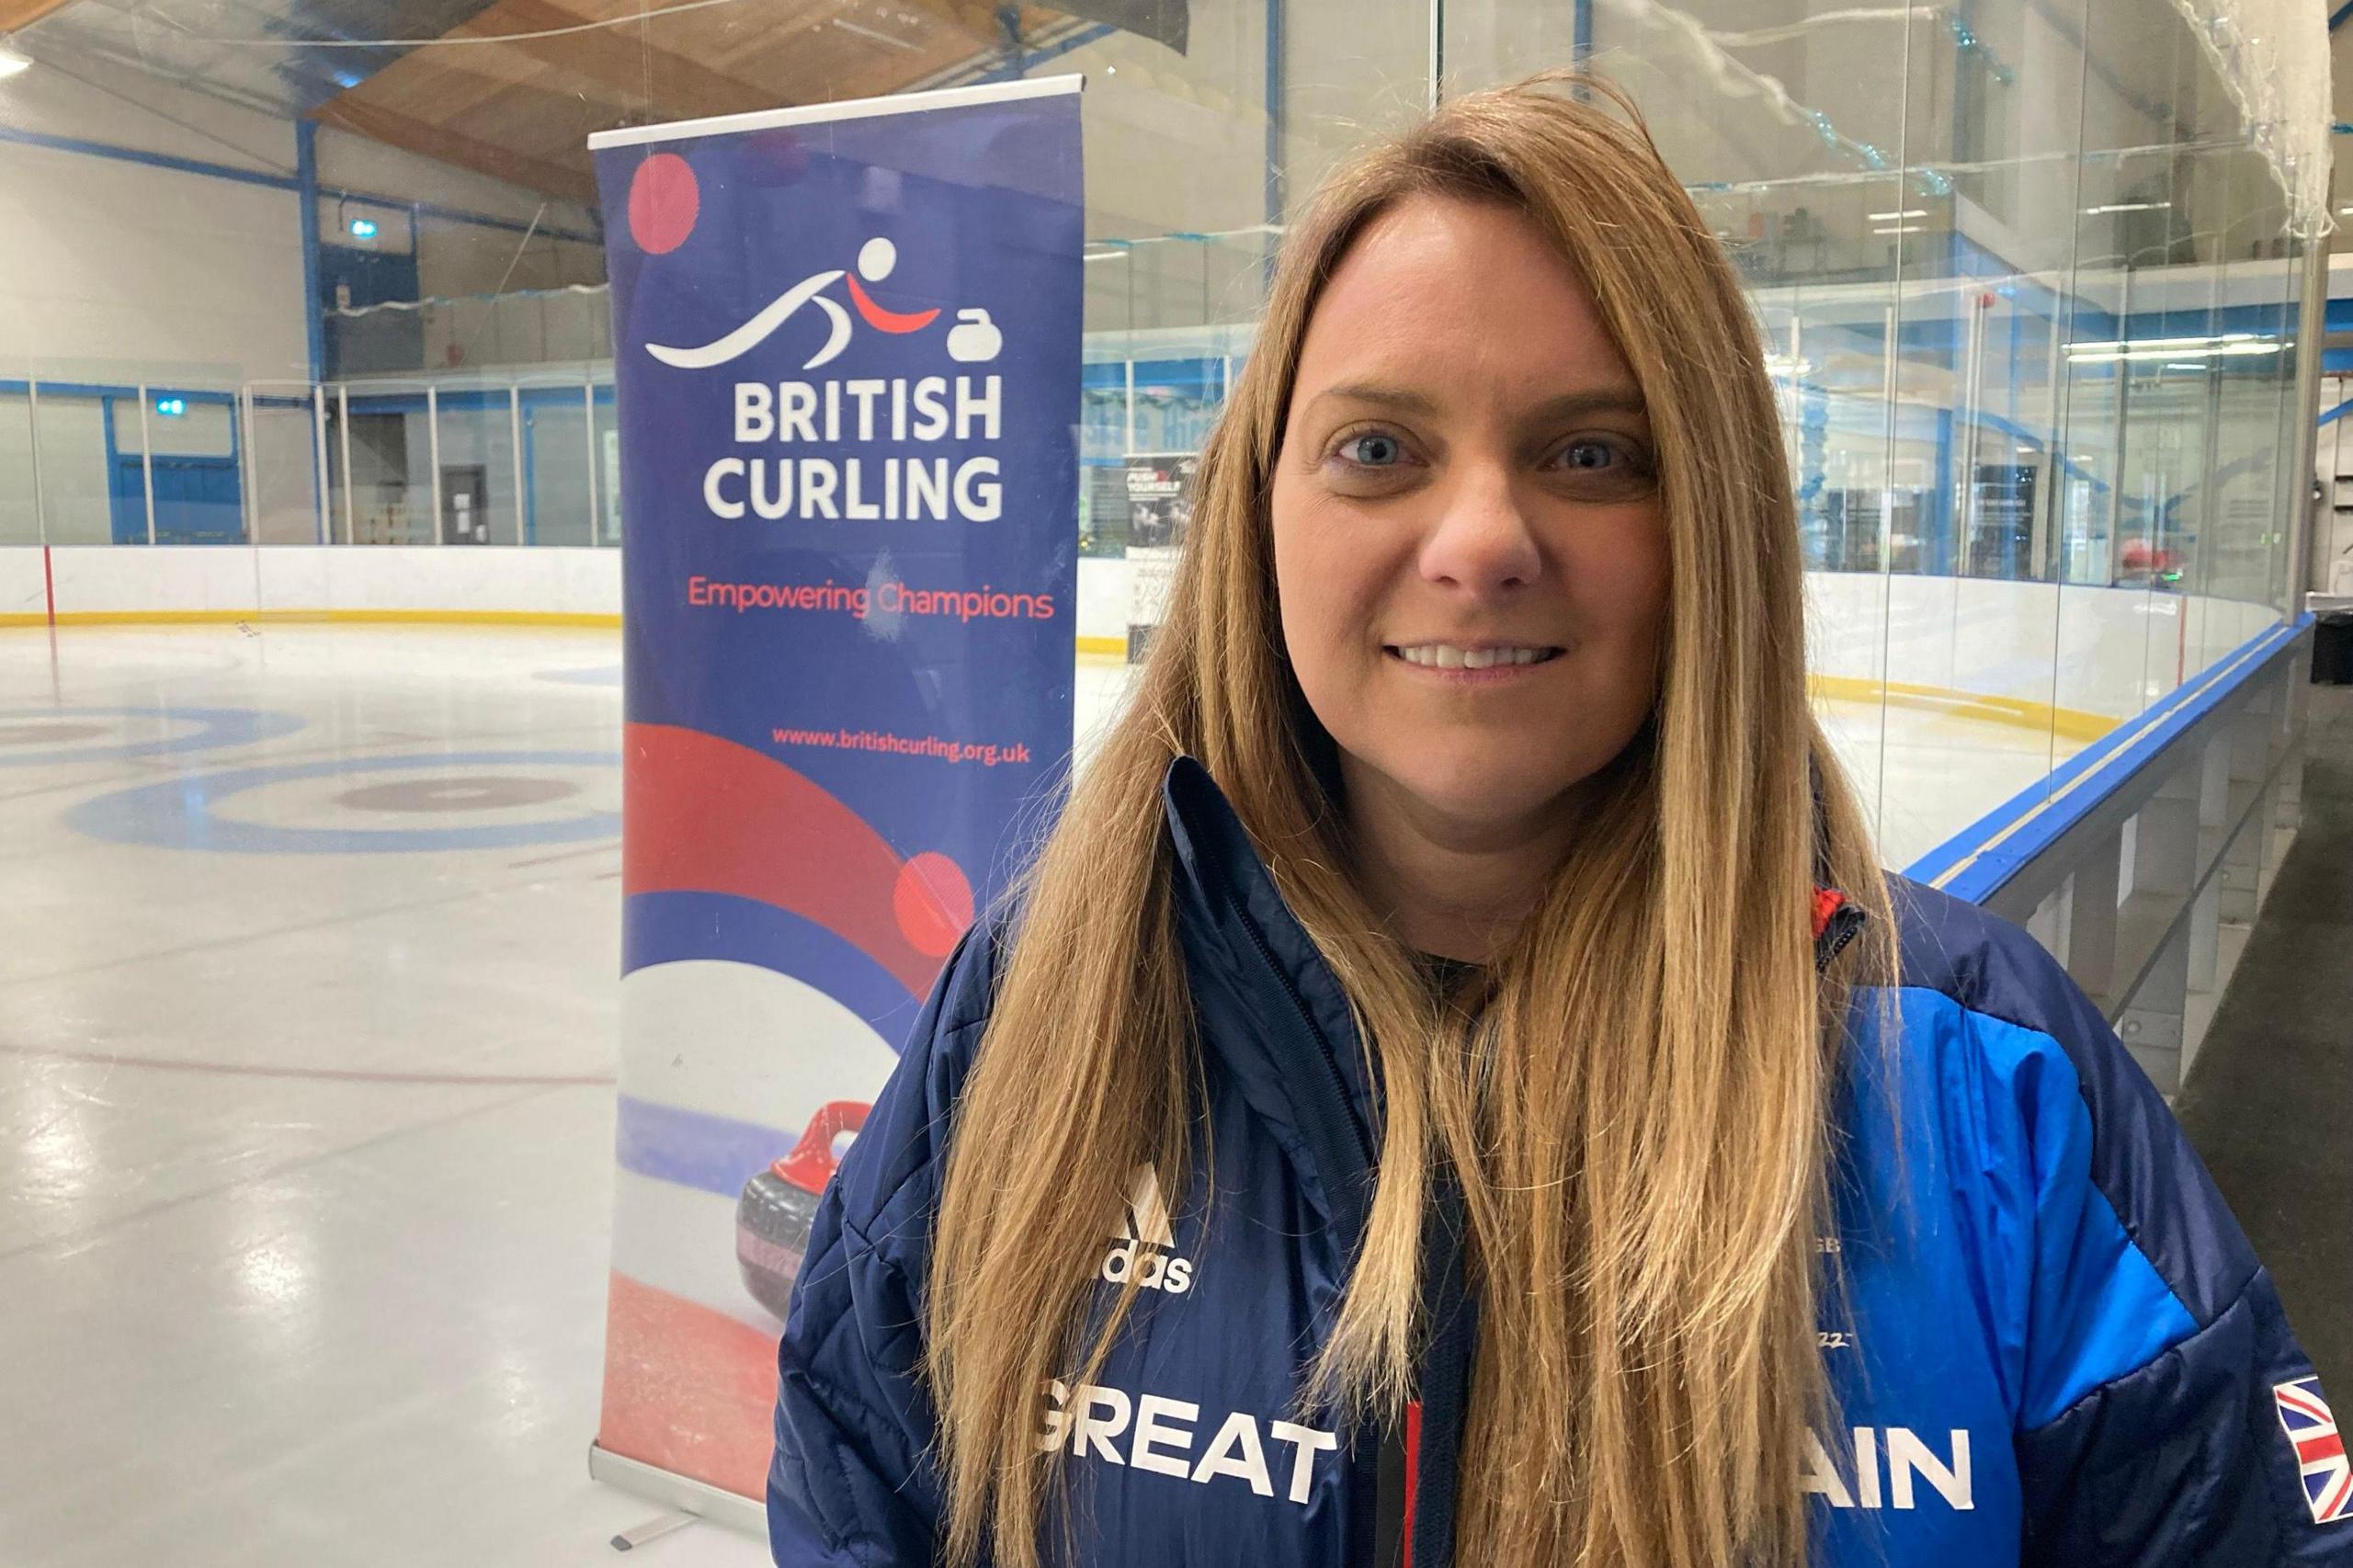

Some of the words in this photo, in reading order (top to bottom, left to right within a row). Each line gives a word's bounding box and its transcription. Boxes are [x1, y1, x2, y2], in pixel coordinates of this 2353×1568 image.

[734, 375, 1003, 442] BRITISH
[703, 457, 1003, 522] CURLING
[688, 575, 869, 619] Empowering
[877, 583, 1055, 623] Champions
[772, 728, 1030, 767] www.britishcurling.org.uk
[1092, 1238, 1193, 1294] das
[1035, 1379, 1338, 1506] GREAT
